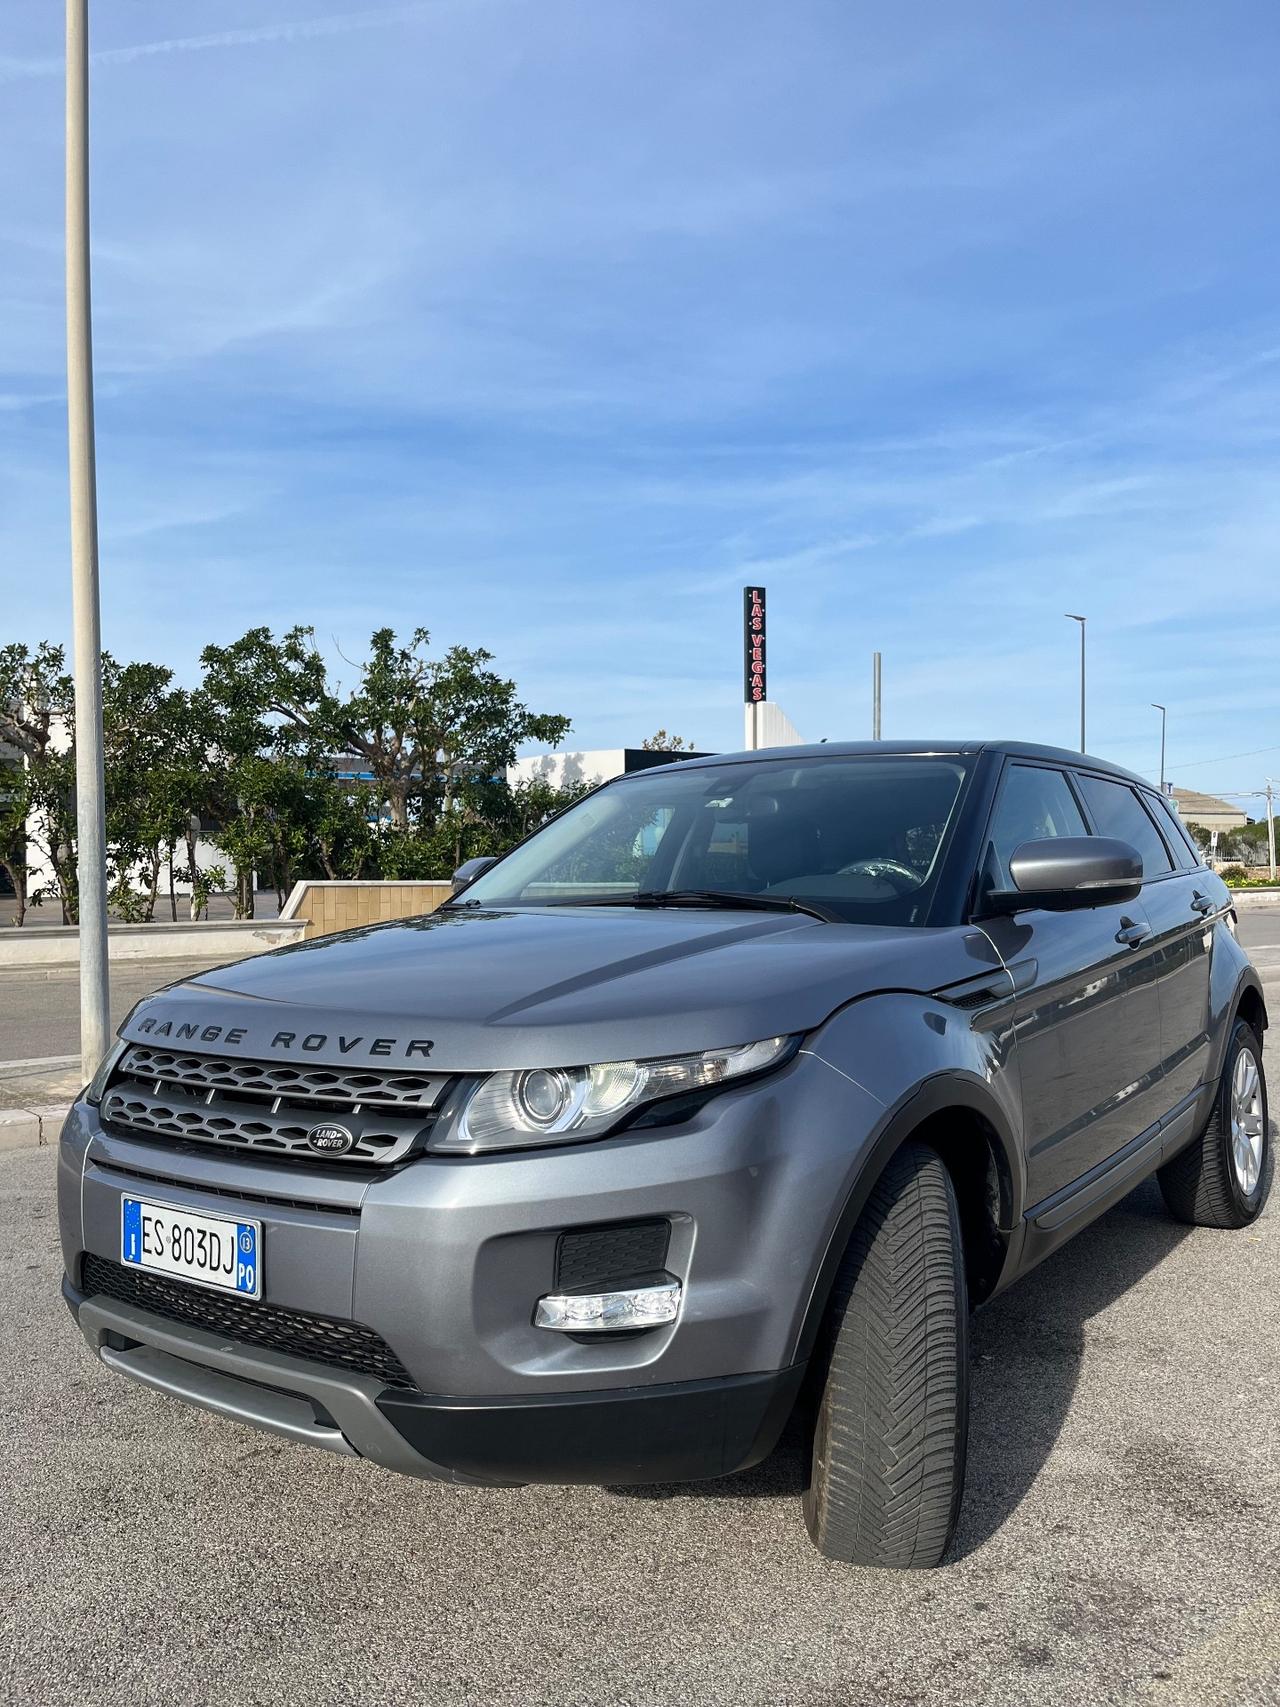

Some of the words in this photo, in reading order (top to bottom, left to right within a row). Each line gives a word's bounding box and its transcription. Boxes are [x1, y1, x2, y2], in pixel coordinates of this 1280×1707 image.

[751, 591, 763, 630] LAS
[751, 634, 763, 700] VEGAS
[138, 1018, 247, 1044] RANGE
[271, 1032, 435, 1057] ROVER
[142, 1216, 164, 1256] ES
[242, 1235, 251, 1251] 13
